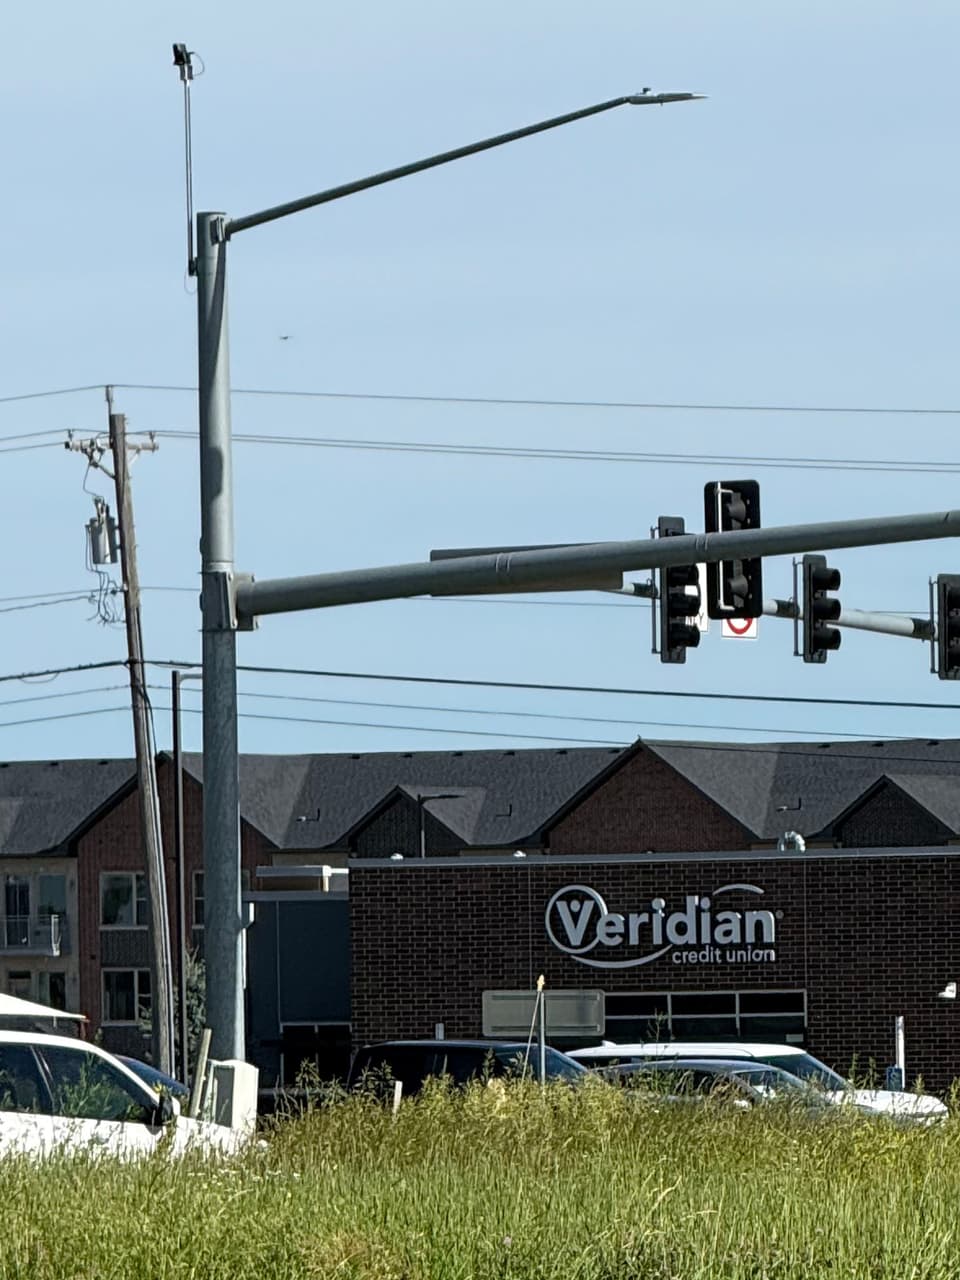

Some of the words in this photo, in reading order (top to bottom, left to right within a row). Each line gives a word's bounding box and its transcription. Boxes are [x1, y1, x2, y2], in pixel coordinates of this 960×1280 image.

[555, 895, 776, 946] Veridian
[672, 945, 721, 964] credit
[726, 945, 776, 963] union
